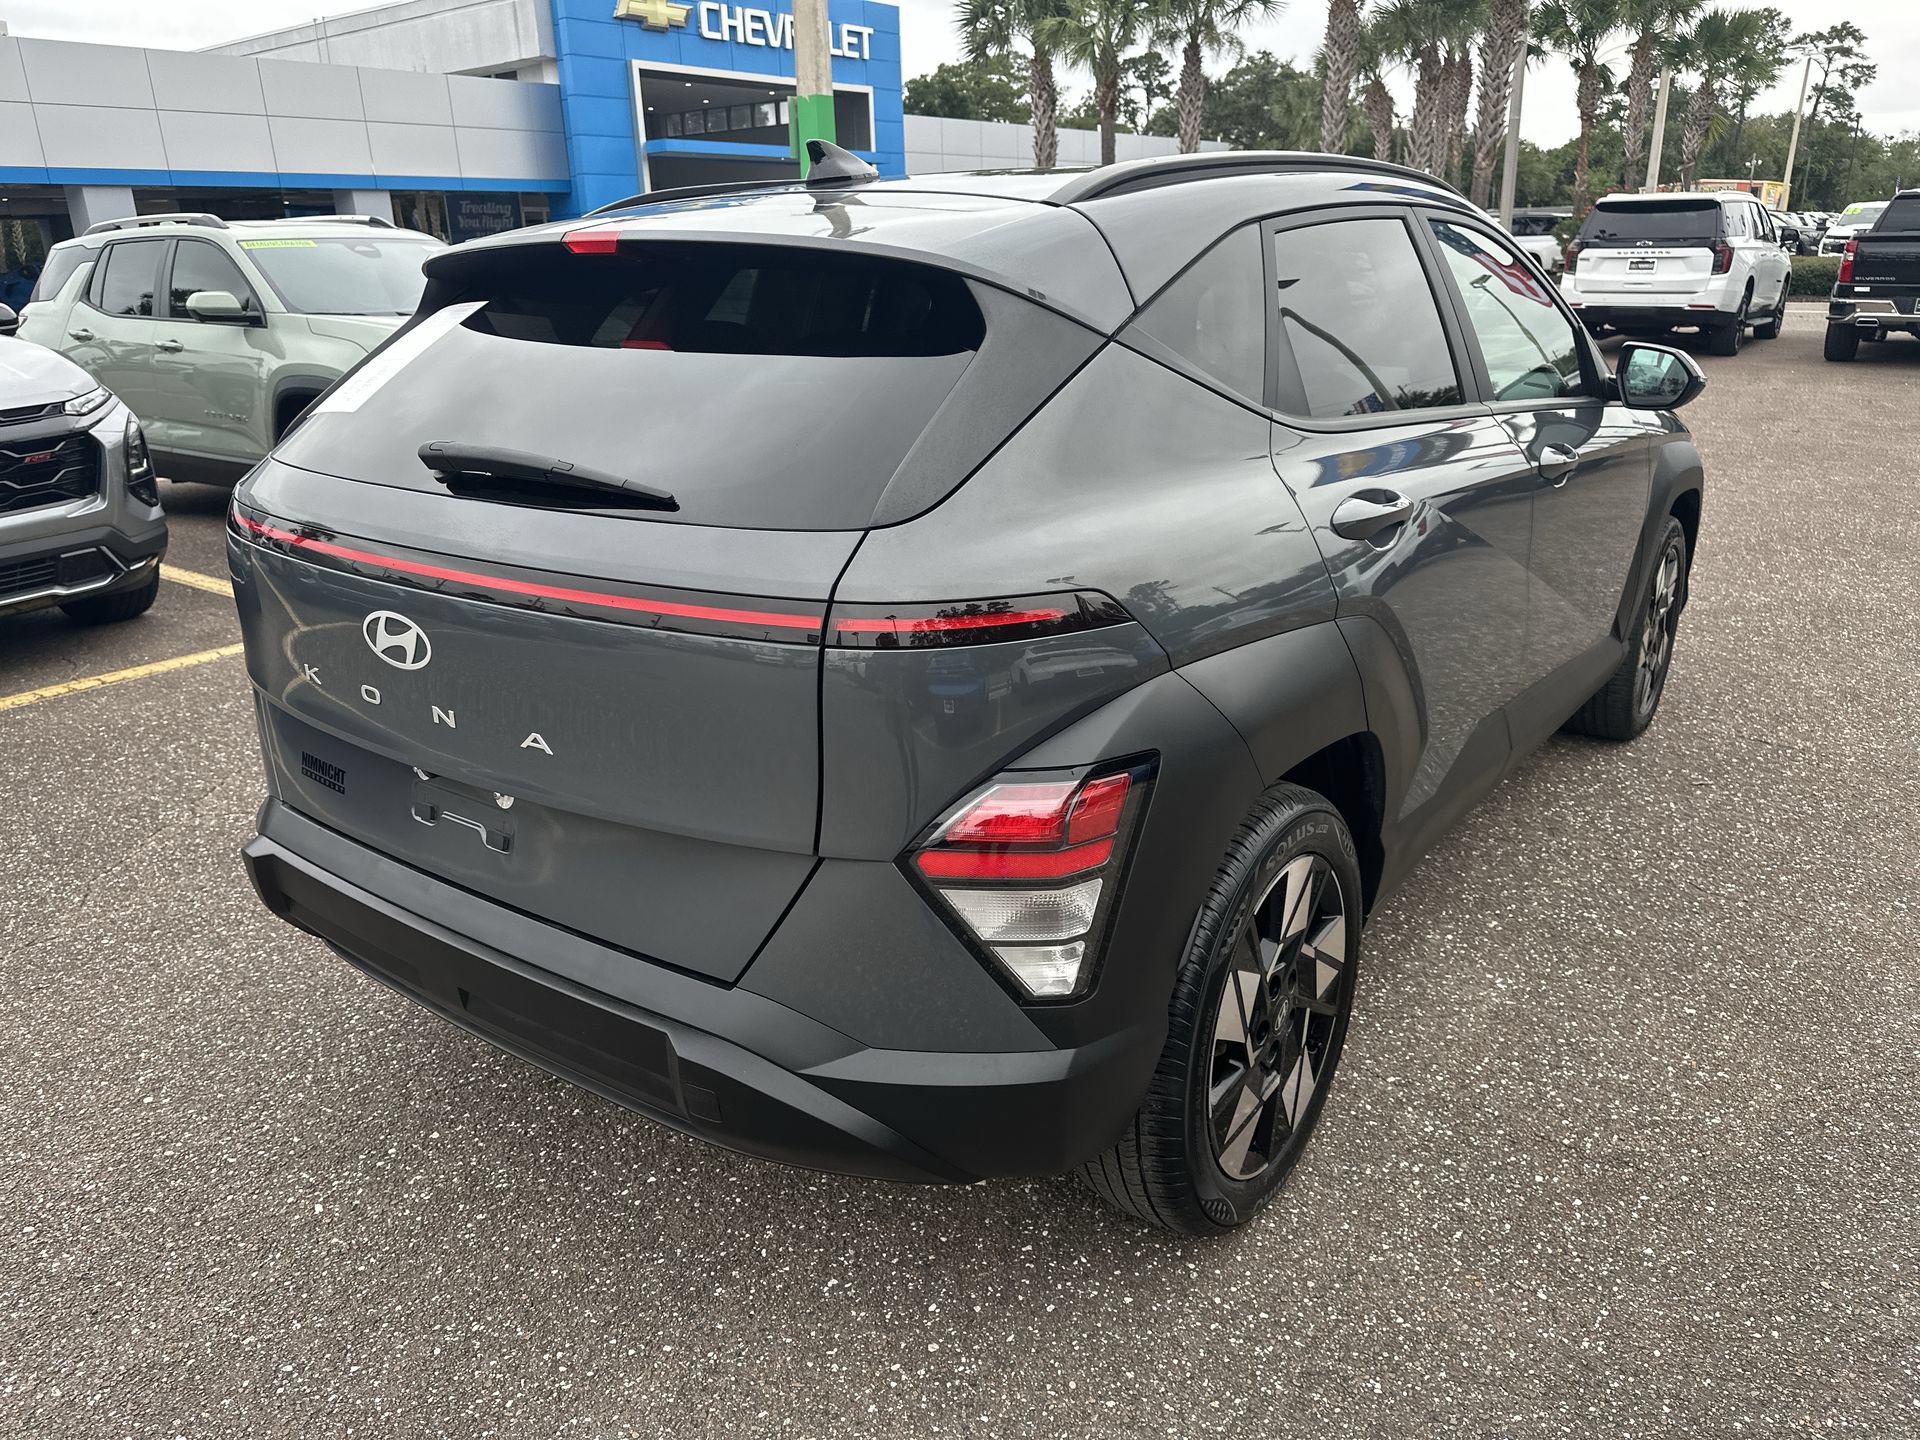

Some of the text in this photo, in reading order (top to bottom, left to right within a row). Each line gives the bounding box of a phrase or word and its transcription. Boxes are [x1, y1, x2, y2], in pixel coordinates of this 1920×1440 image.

[698, 1, 874, 60] CHEVRLET
[458, 215, 514, 231] You Right
[459, 201, 512, 217] Treating
[303, 663, 554, 756] KONA
[301, 750, 347, 786] NIMNICHT
[1265, 822, 1316, 870] SOLUS
